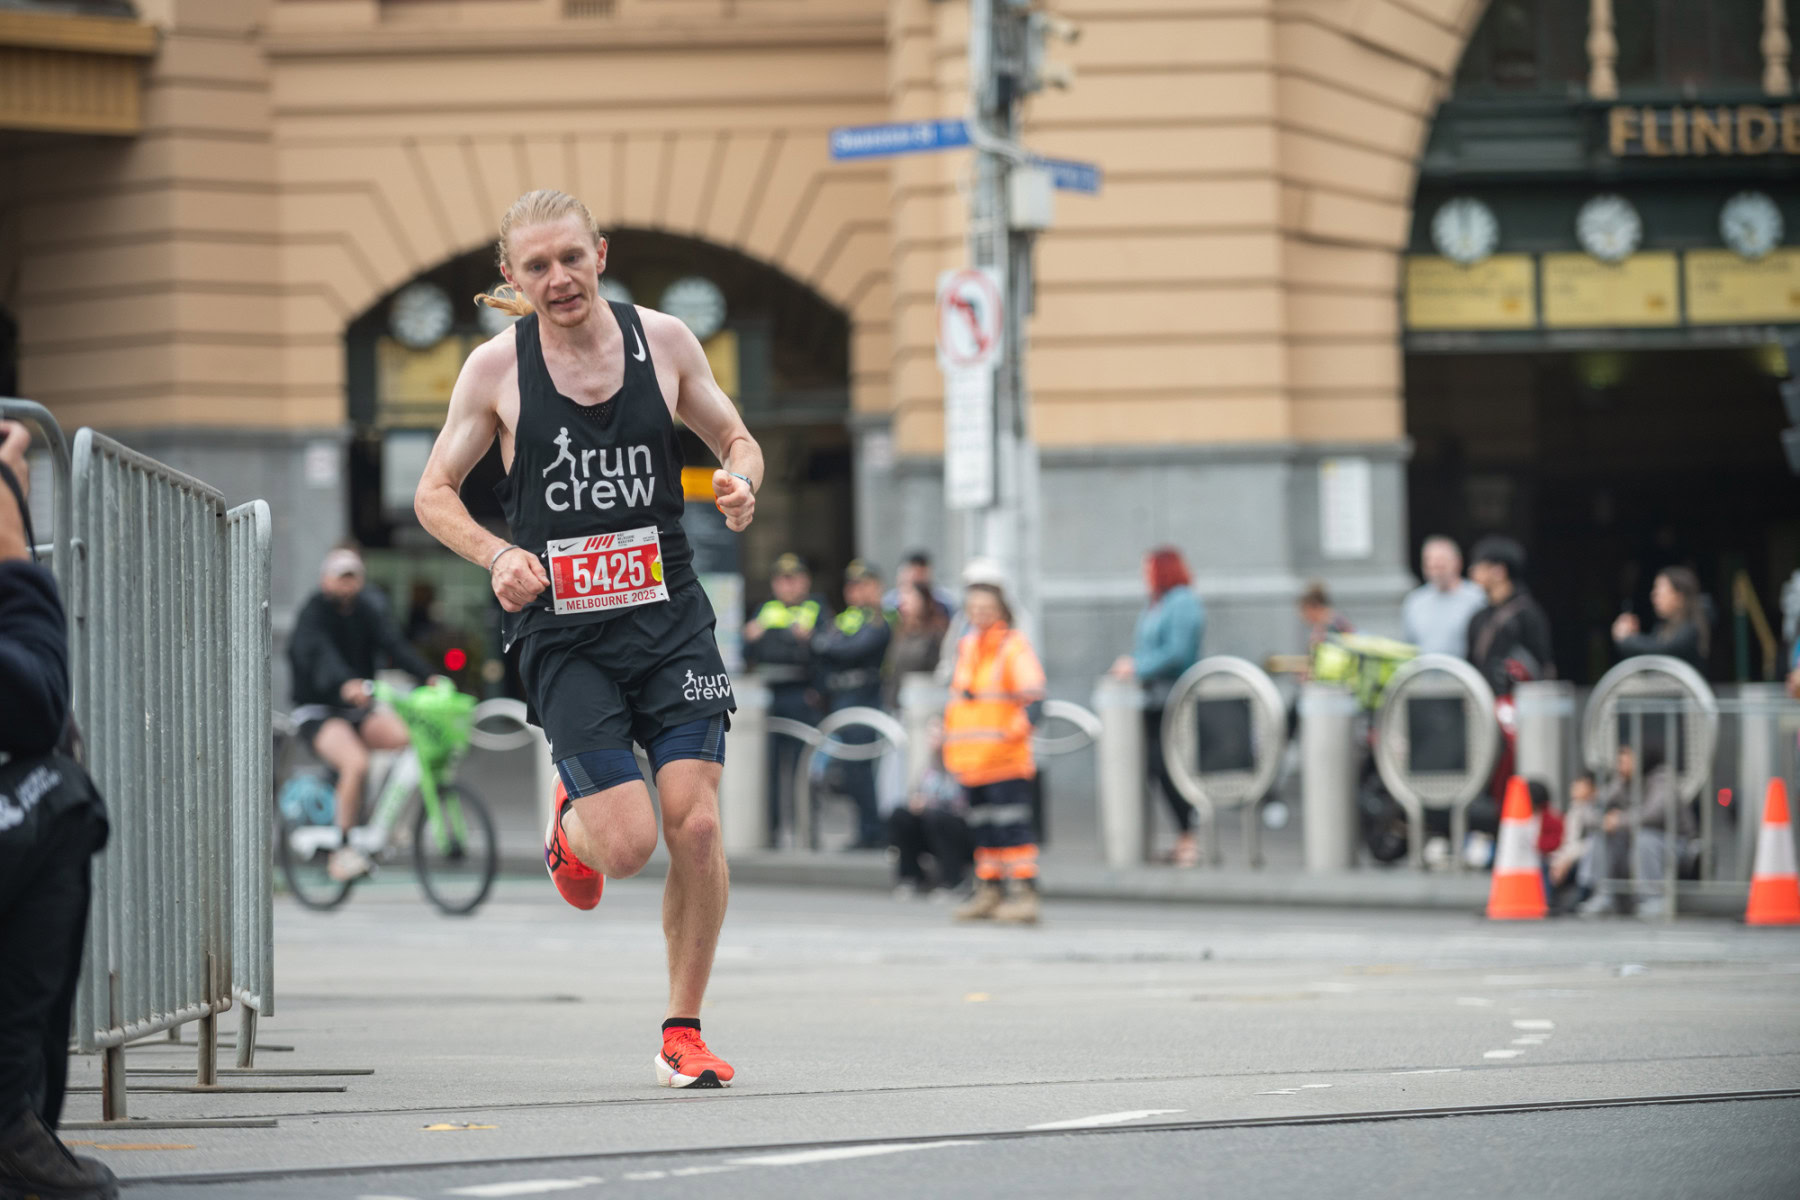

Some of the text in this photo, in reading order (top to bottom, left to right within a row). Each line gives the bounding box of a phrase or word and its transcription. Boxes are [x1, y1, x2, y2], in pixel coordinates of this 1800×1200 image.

[581, 445, 652, 478] run
[545, 477, 655, 511] crew
[572, 550, 645, 594] 5425
[566, 589, 656, 611] MELBOURNE 2025
[684, 685, 731, 701] crew
[697, 673, 728, 688] run
